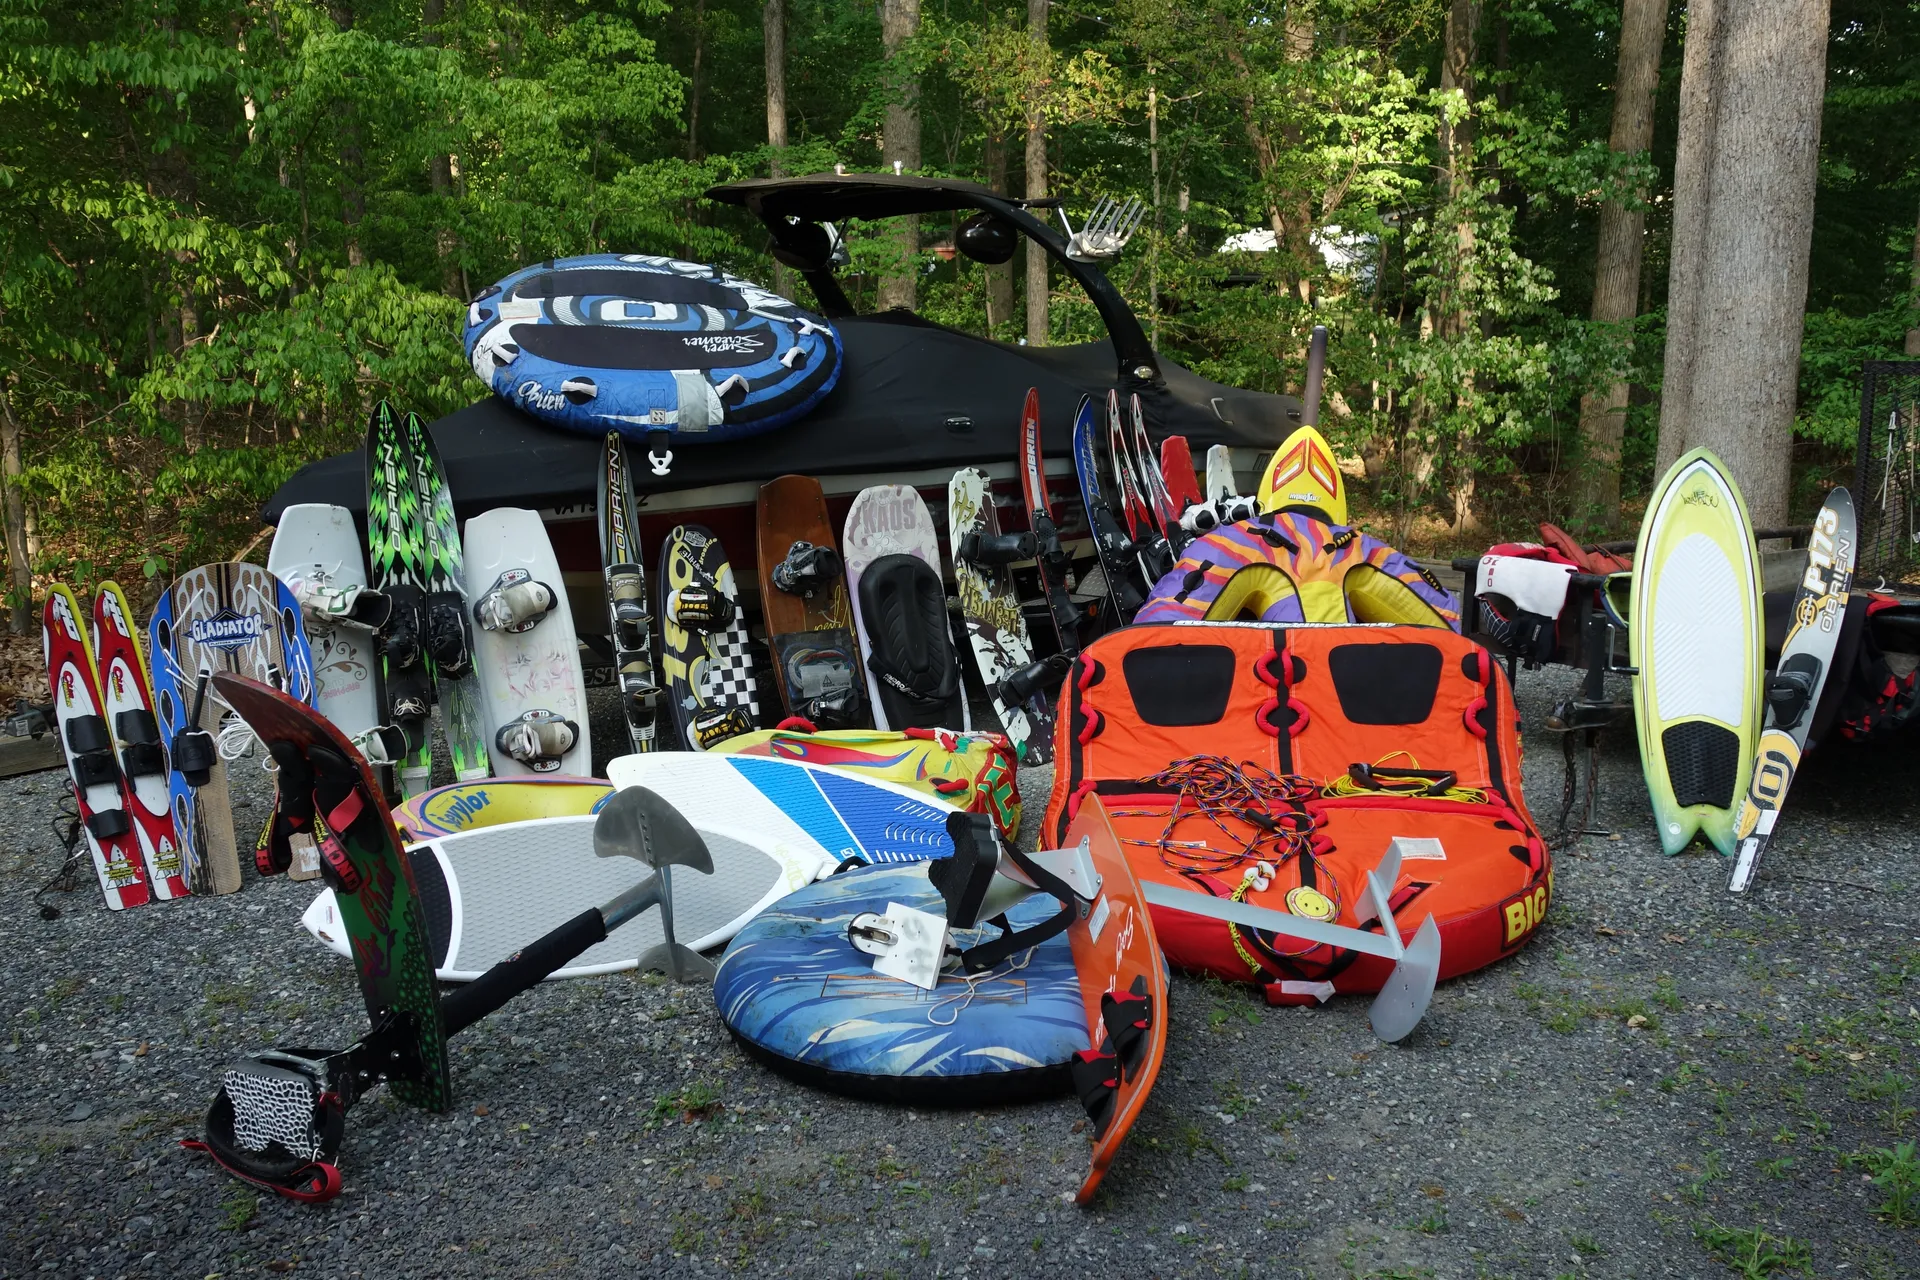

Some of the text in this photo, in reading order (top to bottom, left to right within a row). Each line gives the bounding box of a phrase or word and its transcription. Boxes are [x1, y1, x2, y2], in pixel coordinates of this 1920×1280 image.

[682, 332, 765, 347] Screamer
[702, 342, 755, 353] Super
[860, 499, 917, 534] KAOS
[1802, 505, 1839, 595] P173
[1505, 887, 1546, 945] BIG
